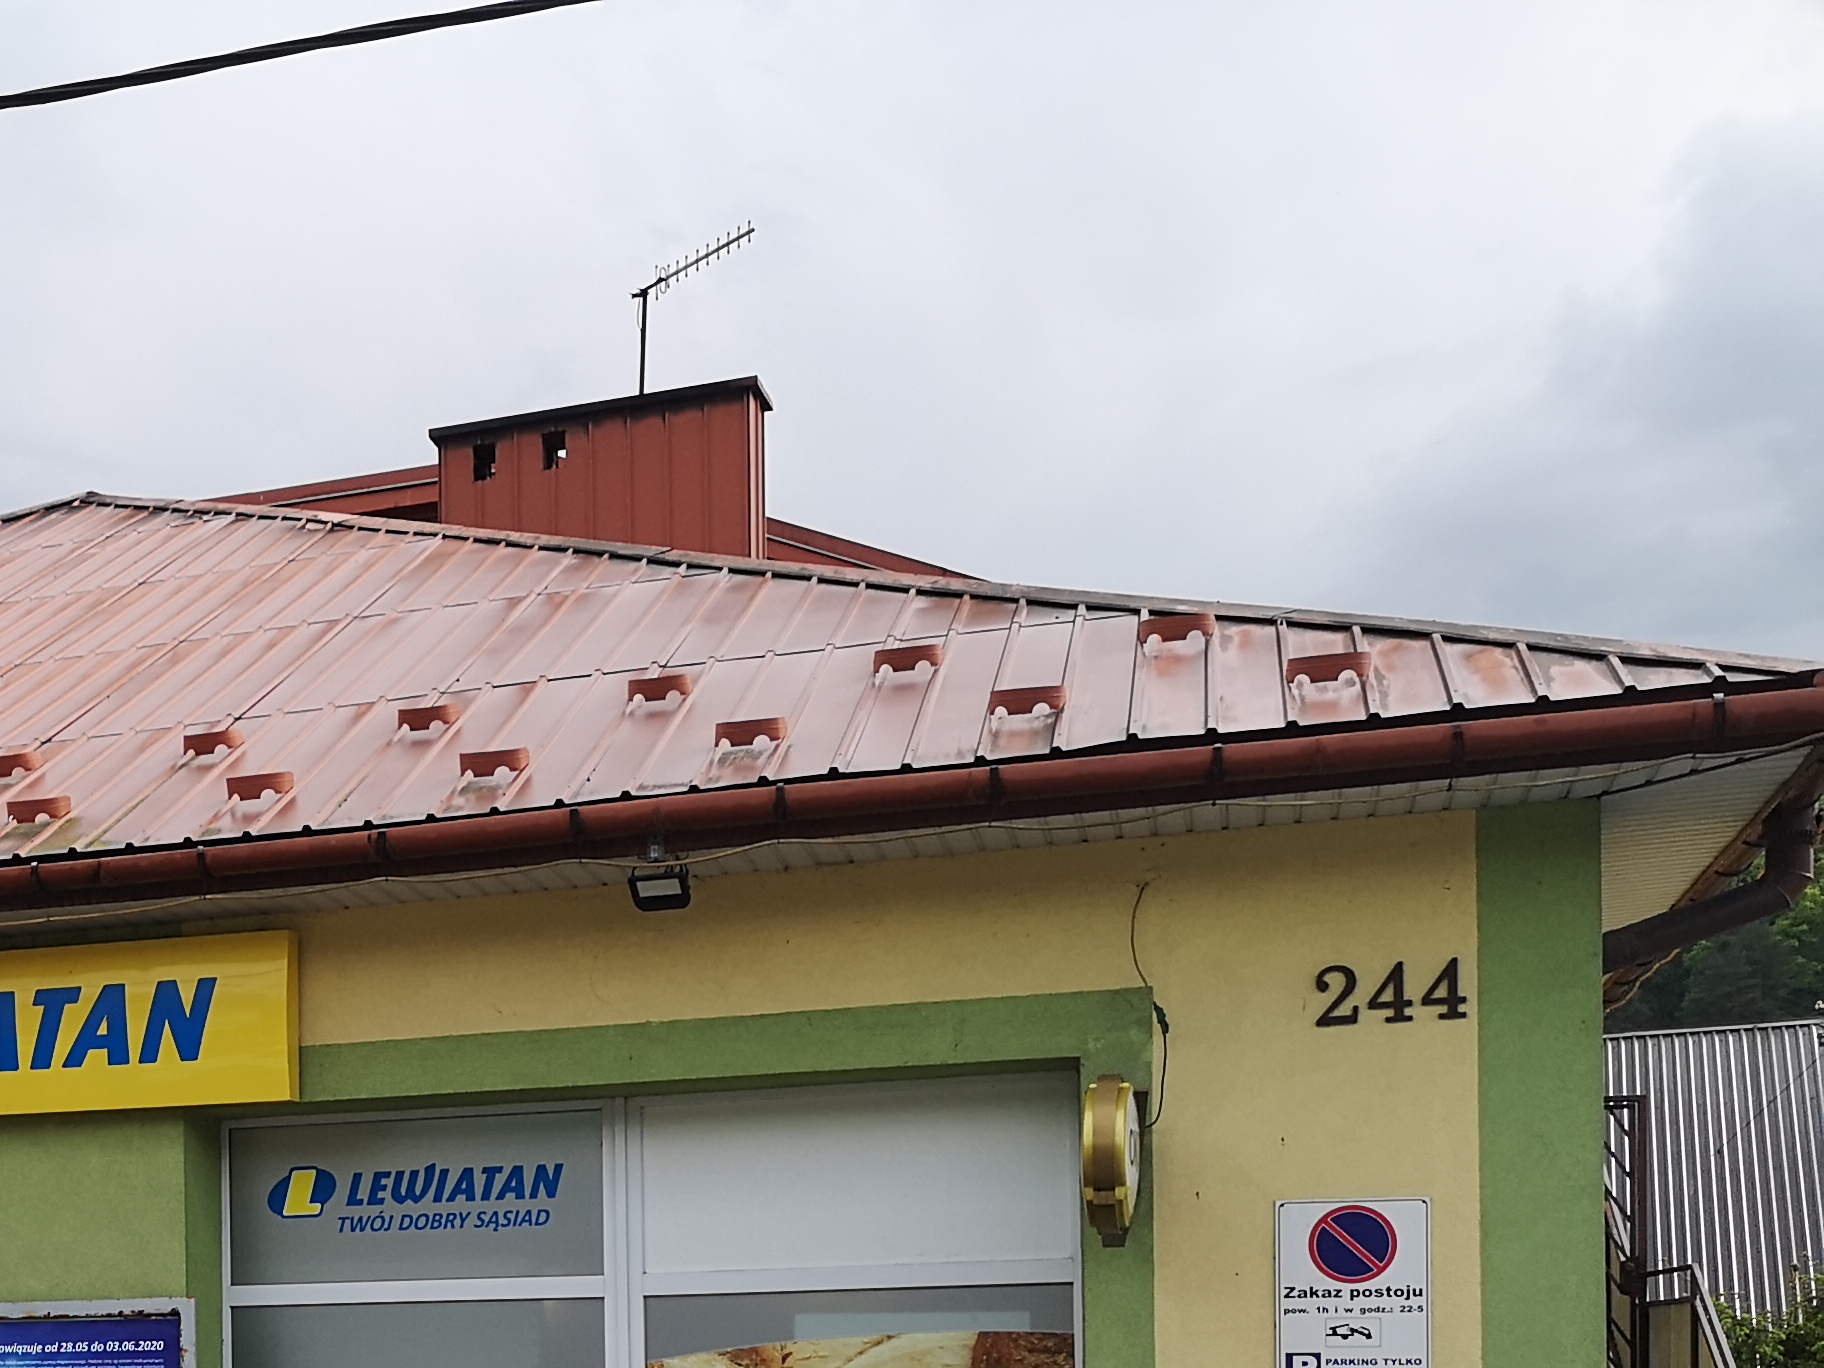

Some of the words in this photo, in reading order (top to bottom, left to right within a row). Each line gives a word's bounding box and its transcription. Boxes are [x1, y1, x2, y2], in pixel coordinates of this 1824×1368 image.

[1315, 957, 1467, 1027] 244
[345, 1162, 564, 1206] LEWIATAN
[337, 1210, 394, 1233] TWÓJ
[398, 1211, 472, 1231] DOBRY
[473, 1208, 551, 1232] SĄSIAD
[1283, 1286, 1343, 1299] Zakaz
[1349, 1285, 1424, 1301] postoju
[1283, 1307, 1310, 1315] pow.
[1316, 1306, 1329, 1314] 1h
[1399, 1305, 1424, 1313] 22-5
[44, 1341, 59, 1353] od
[60, 1341, 89, 1352] 28.05
[90, 1341, 104, 1352] do
[105, 1340, 164, 1352] 03.06.2020
[1325, 1358, 1378, 1366] PARKING
[1382, 1357, 1422, 1366] TYLKO
